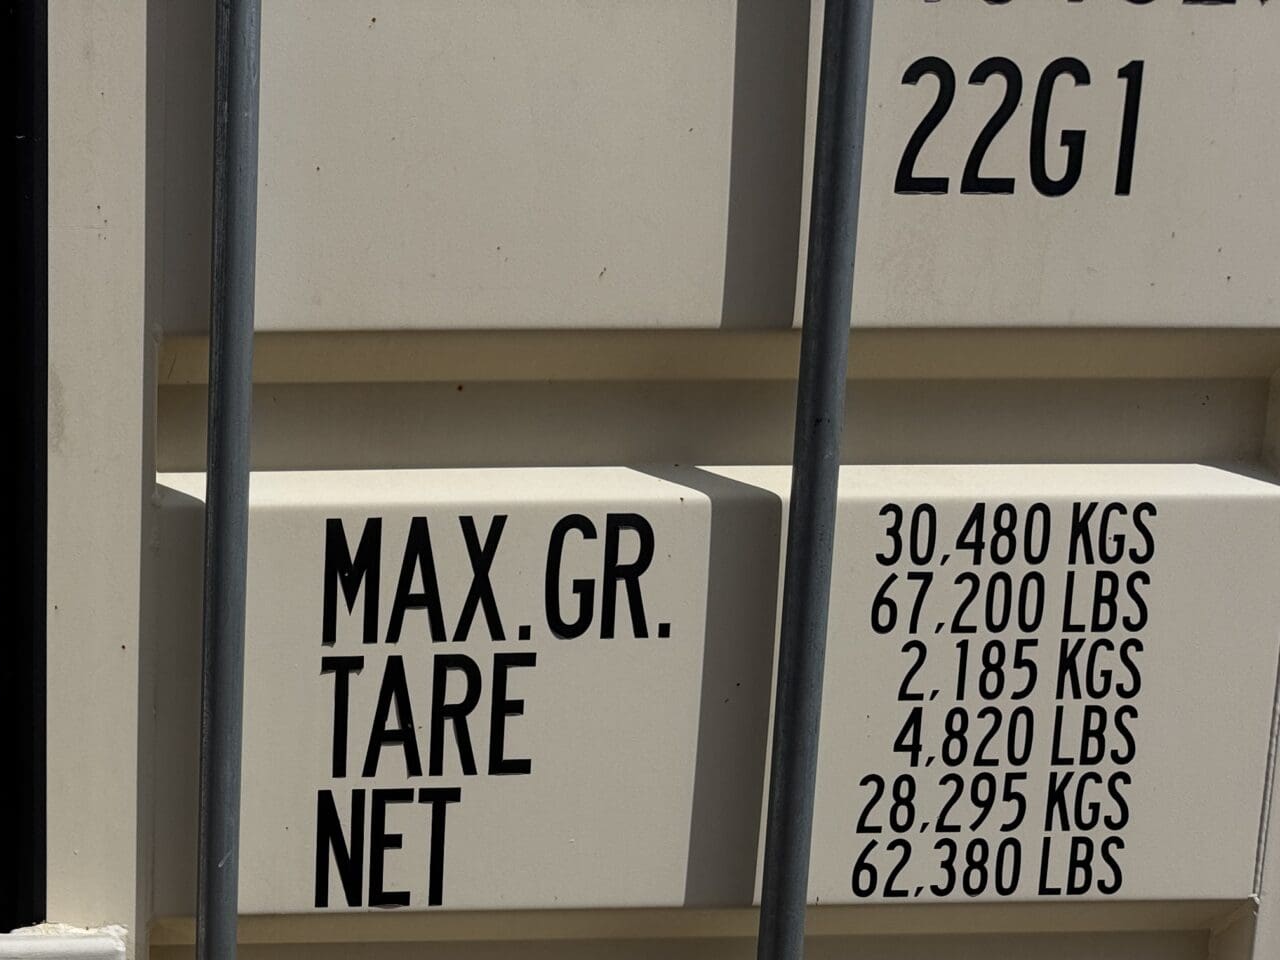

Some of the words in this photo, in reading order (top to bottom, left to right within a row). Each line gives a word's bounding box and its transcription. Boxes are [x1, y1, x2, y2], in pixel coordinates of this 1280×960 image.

[894, 56, 1144, 196] 22G1
[875, 503, 1051, 566] 30,480
[1068, 502, 1157, 565] KGS
[871, 571, 1045, 634] 67,200
[1062, 570, 1151, 633] LBS
[897, 639, 1039, 701] 2,185
[1055, 638, 1144, 700] KGS
[321, 652, 537, 779] TARE
[893, 706, 1034, 767] 4,820
[1050, 705, 1139, 766] LBS
[855, 772, 1027, 834] 28,295
[1044, 771, 1132, 832] KGS
[314, 787, 462, 908] NET
[851, 837, 1022, 898] 62,380
[1038, 836, 1125, 896] LBS
